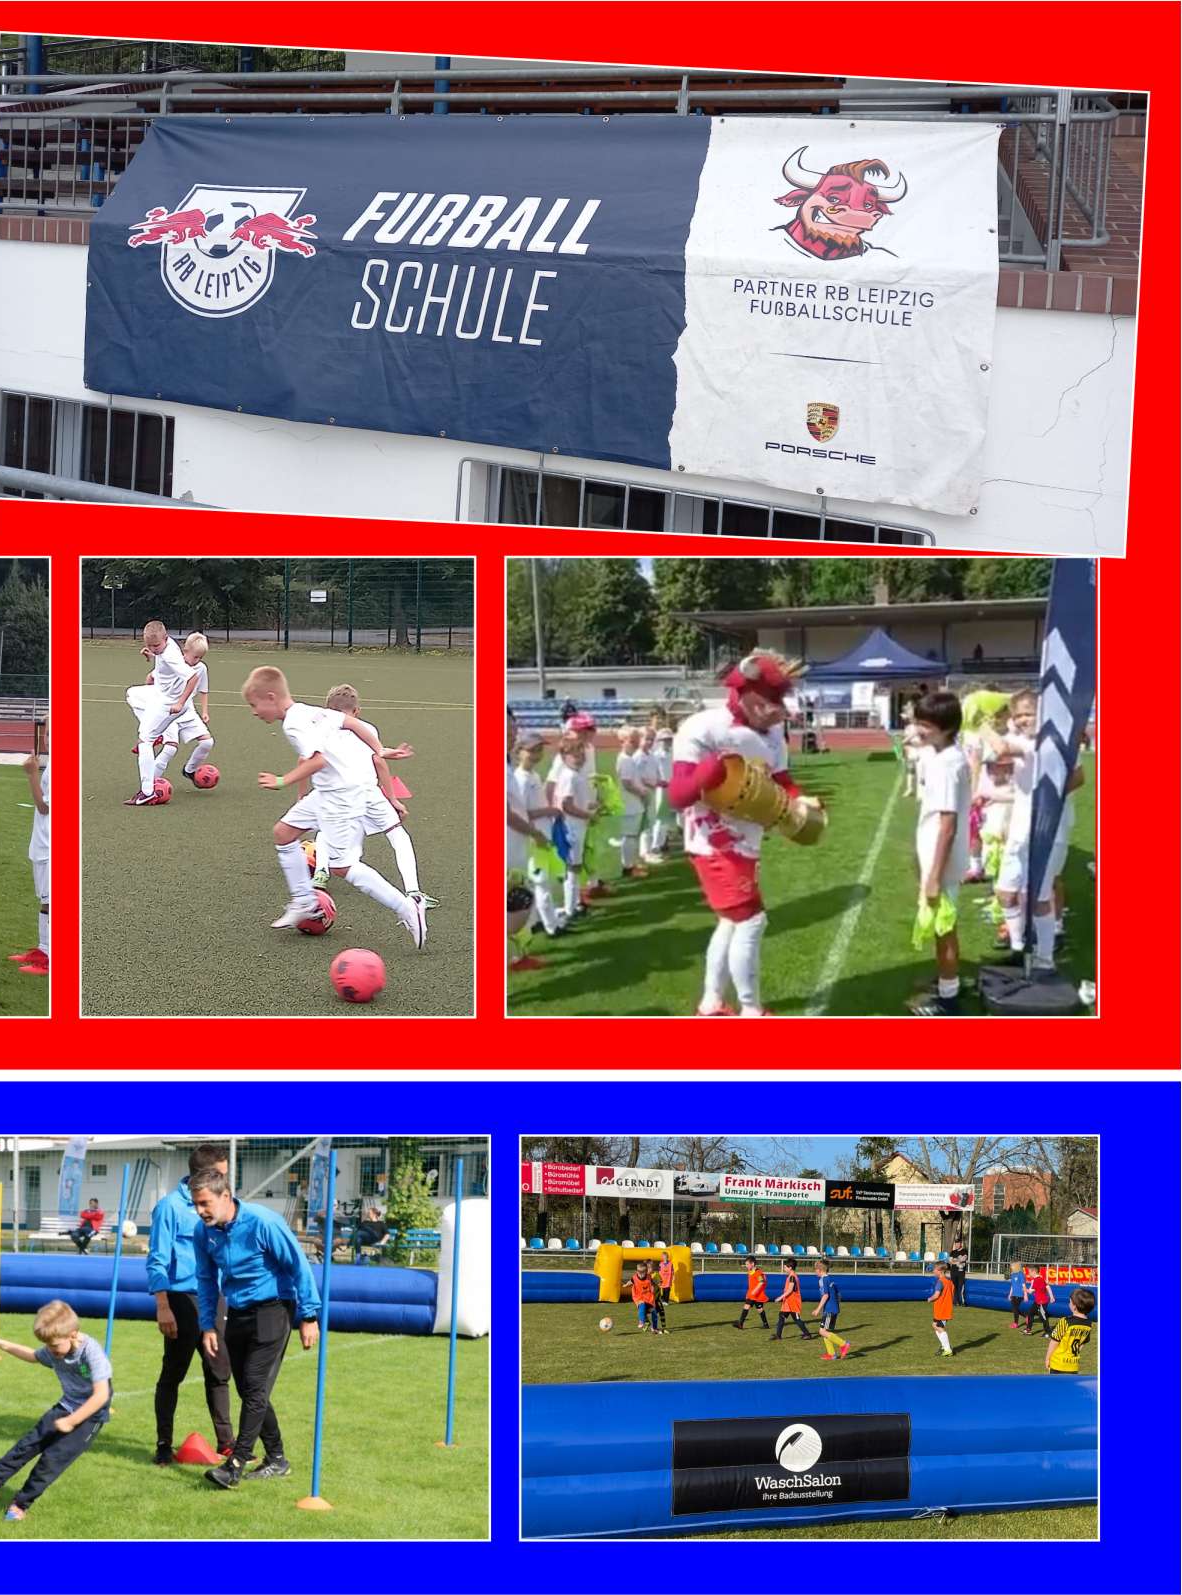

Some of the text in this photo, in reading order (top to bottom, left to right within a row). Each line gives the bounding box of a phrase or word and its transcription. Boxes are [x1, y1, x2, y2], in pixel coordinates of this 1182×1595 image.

[342, 191, 602, 255] FUßBALL
[172, 253, 262, 299] RB LEIPZIG
[350, 258, 558, 346] SCHULE
[733, 278, 935, 308] PARTNER RB LEIPZIG
[750, 299, 913, 327] FUßBALLSCHULE
[765, 441, 877, 465] PORSCHE
[616, 1178, 659, 1187] GERNDT
[724, 1176, 821, 1190] Frank Märkisch
[724, 1188, 758, 1196] Umzüge
[765, 1190, 809, 1199] Transporte
[754, 1473, 842, 1490] WaschSalon
[762, 1490, 834, 1501] Ihre Badausstellung
